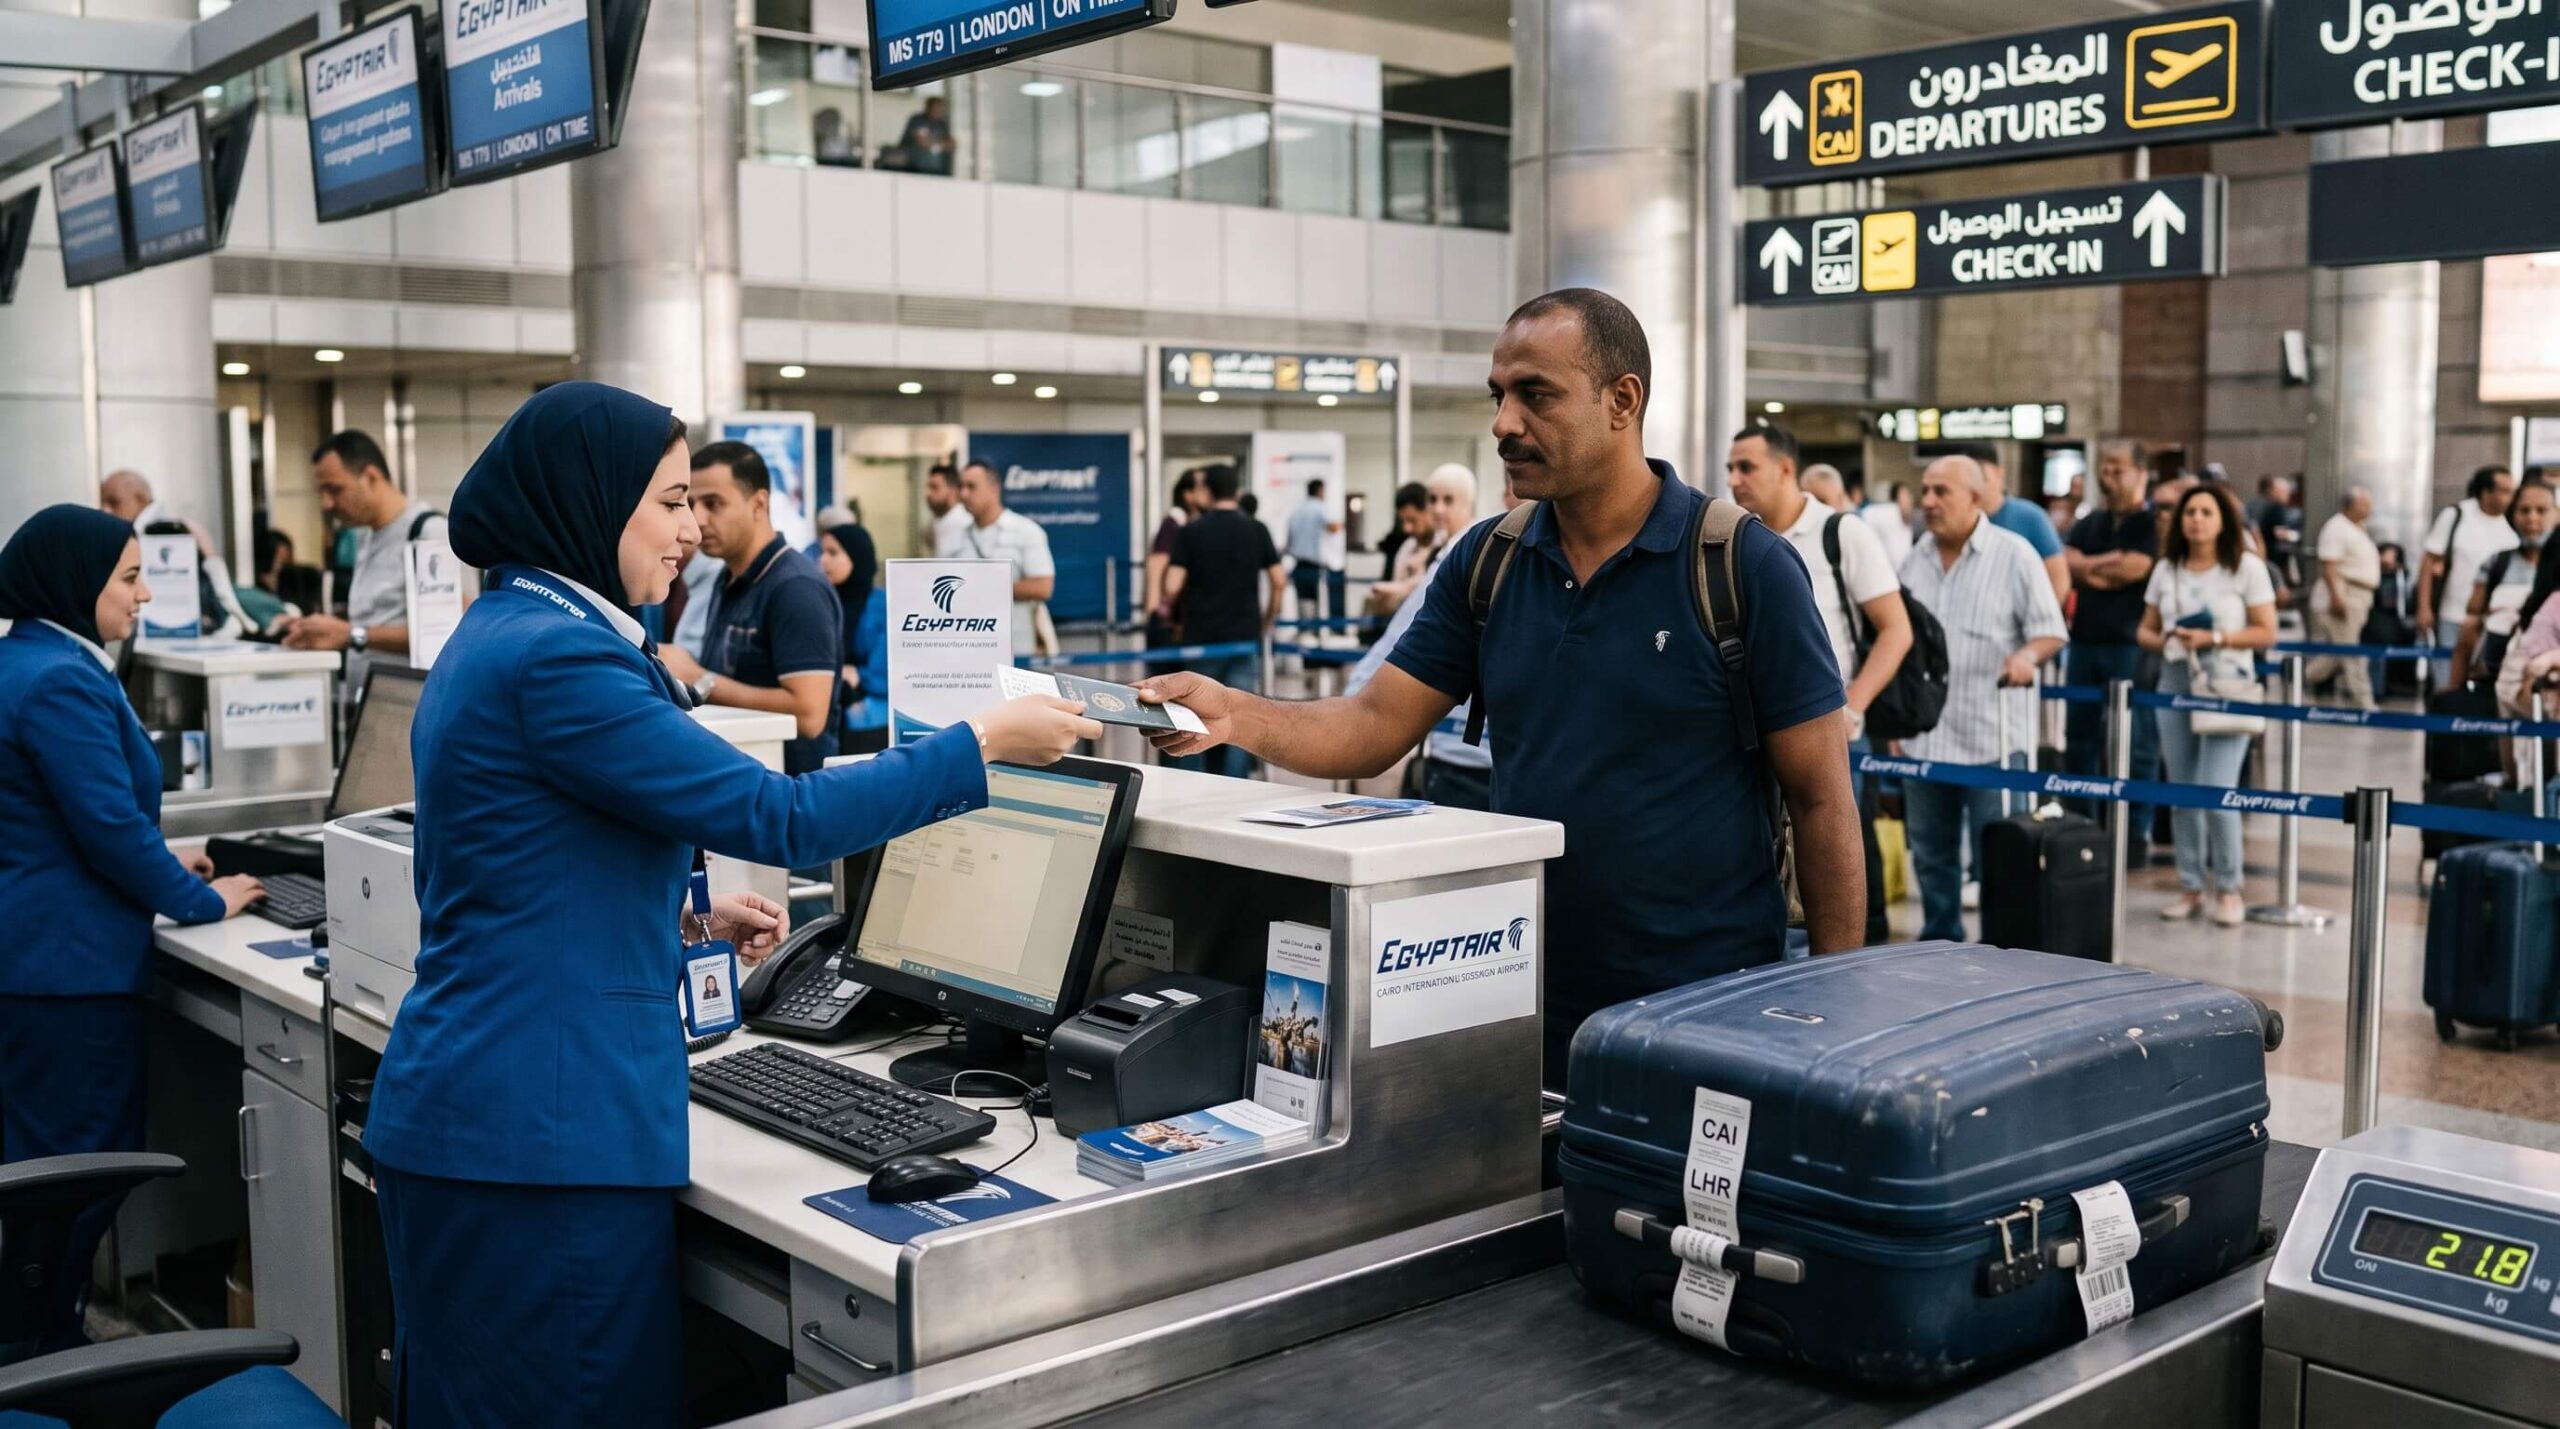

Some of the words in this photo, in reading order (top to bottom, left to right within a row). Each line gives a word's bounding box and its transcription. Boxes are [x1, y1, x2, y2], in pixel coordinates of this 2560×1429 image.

[457, 0, 547, 38] EGYPTA
[888, 39, 913, 65] MS
[915, 29, 944, 57] 779
[960, 3, 1034, 45] LONDON
[1053, 0, 1081, 19] ON
[317, 44, 386, 94] EGYPTAIR
[1909, 32, 2108, 108] المغادرون
[493, 76, 544, 111] Arrivals
[1815, 129, 1855, 156] CAI
[1870, 93, 2107, 159] DEPARTURES
[498, 131, 538, 159] LONDON
[1927, 203, 2022, 245] الوصول
[2024, 196, 2123, 236] تسجيل
[1817, 263, 1853, 286] CAI
[1951, 238, 2103, 283] CHECK-IN
[902, 614, 997, 632] EGYPTAIR
[2221, 790, 2296, 812] EGYPTAIR
[1377, 929, 1505, 974] EGYPTAIR
[1376, 986, 1401, 998] CAIRO
[1497, 962, 1529, 975] AIRPORT
[1702, 1119, 1738, 1146] CAI
[1691, 1168, 1731, 1199] LHR
[2354, 1259, 2378, 1273] ON
[2426, 1232, 2529, 1285] 21.8
[2484, 1292, 2509, 1314] kg
